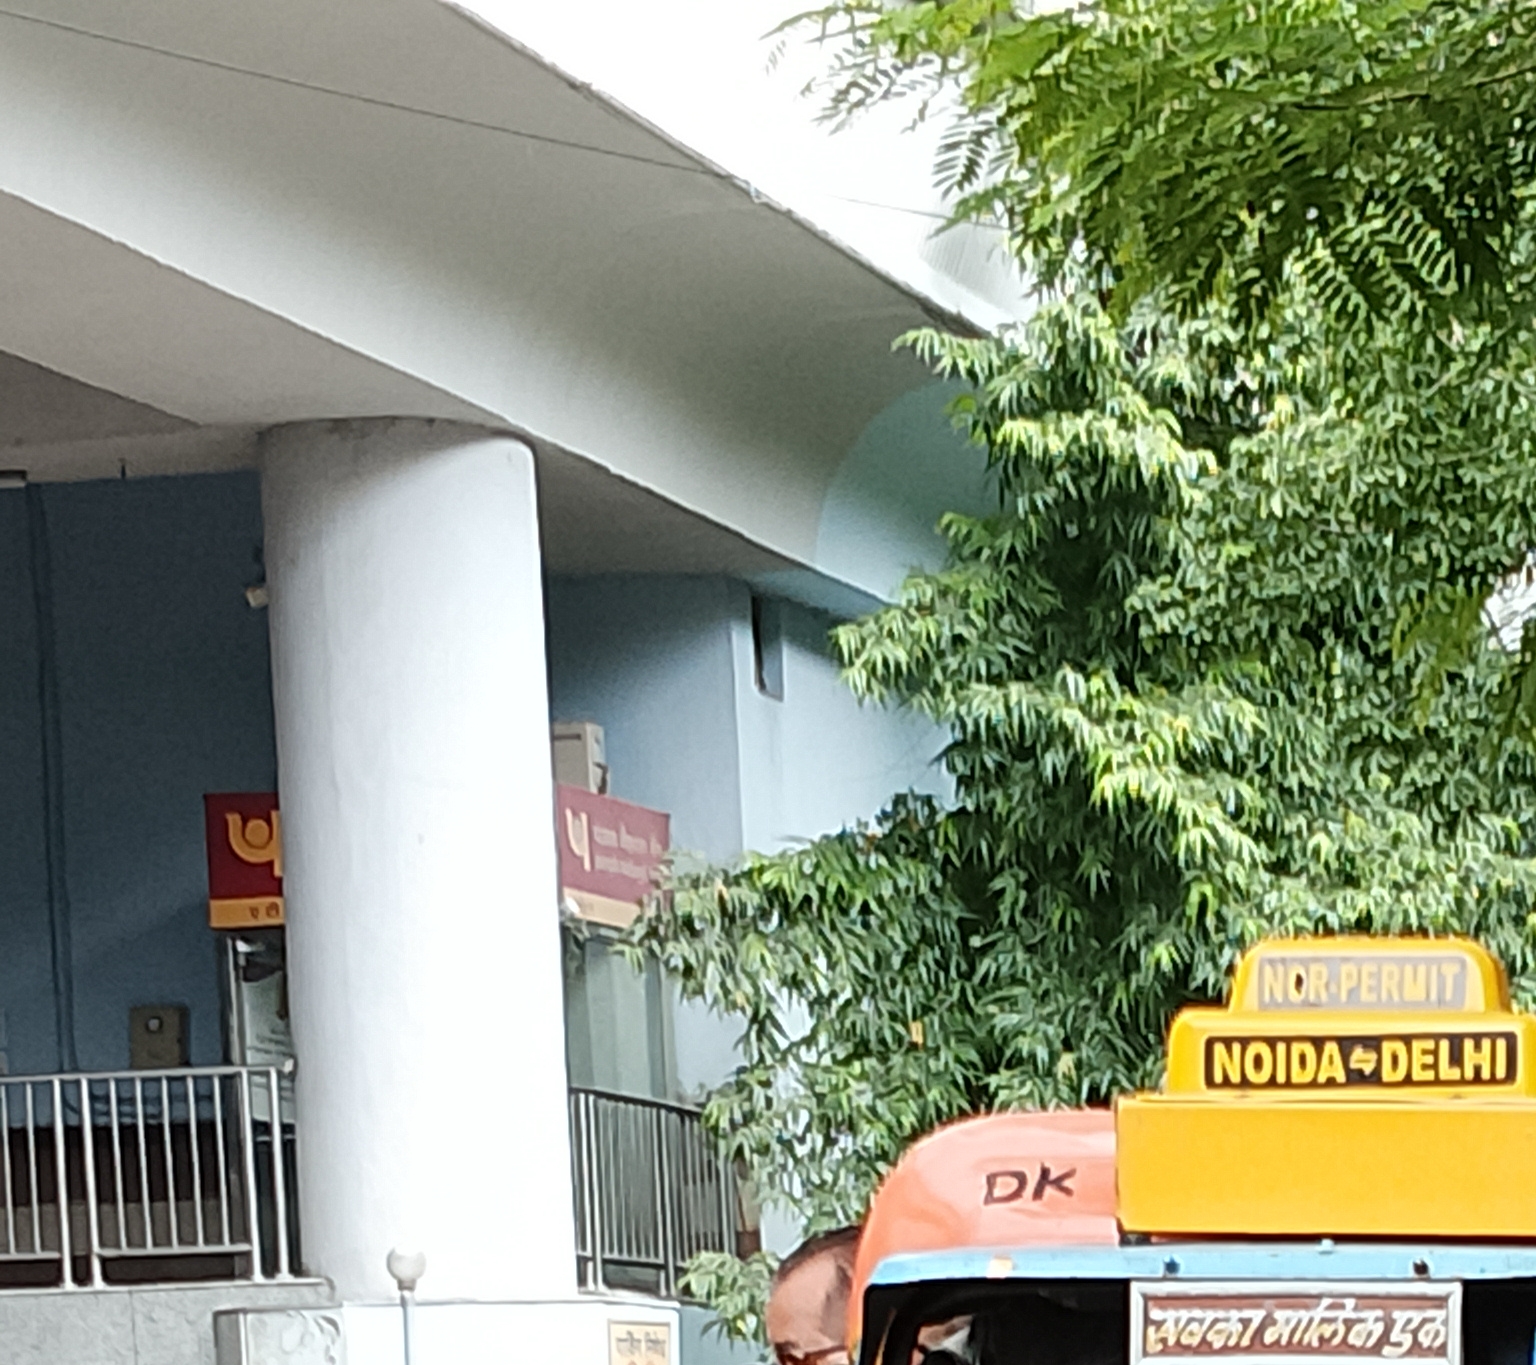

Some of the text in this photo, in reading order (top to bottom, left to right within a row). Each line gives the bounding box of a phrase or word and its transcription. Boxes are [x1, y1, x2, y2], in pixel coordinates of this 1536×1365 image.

[1212, 1037, 1507, 1084] NOIDA DELHI
[984, 1161, 1077, 1206] DK
[1380, 1308, 1447, 1357] एक
